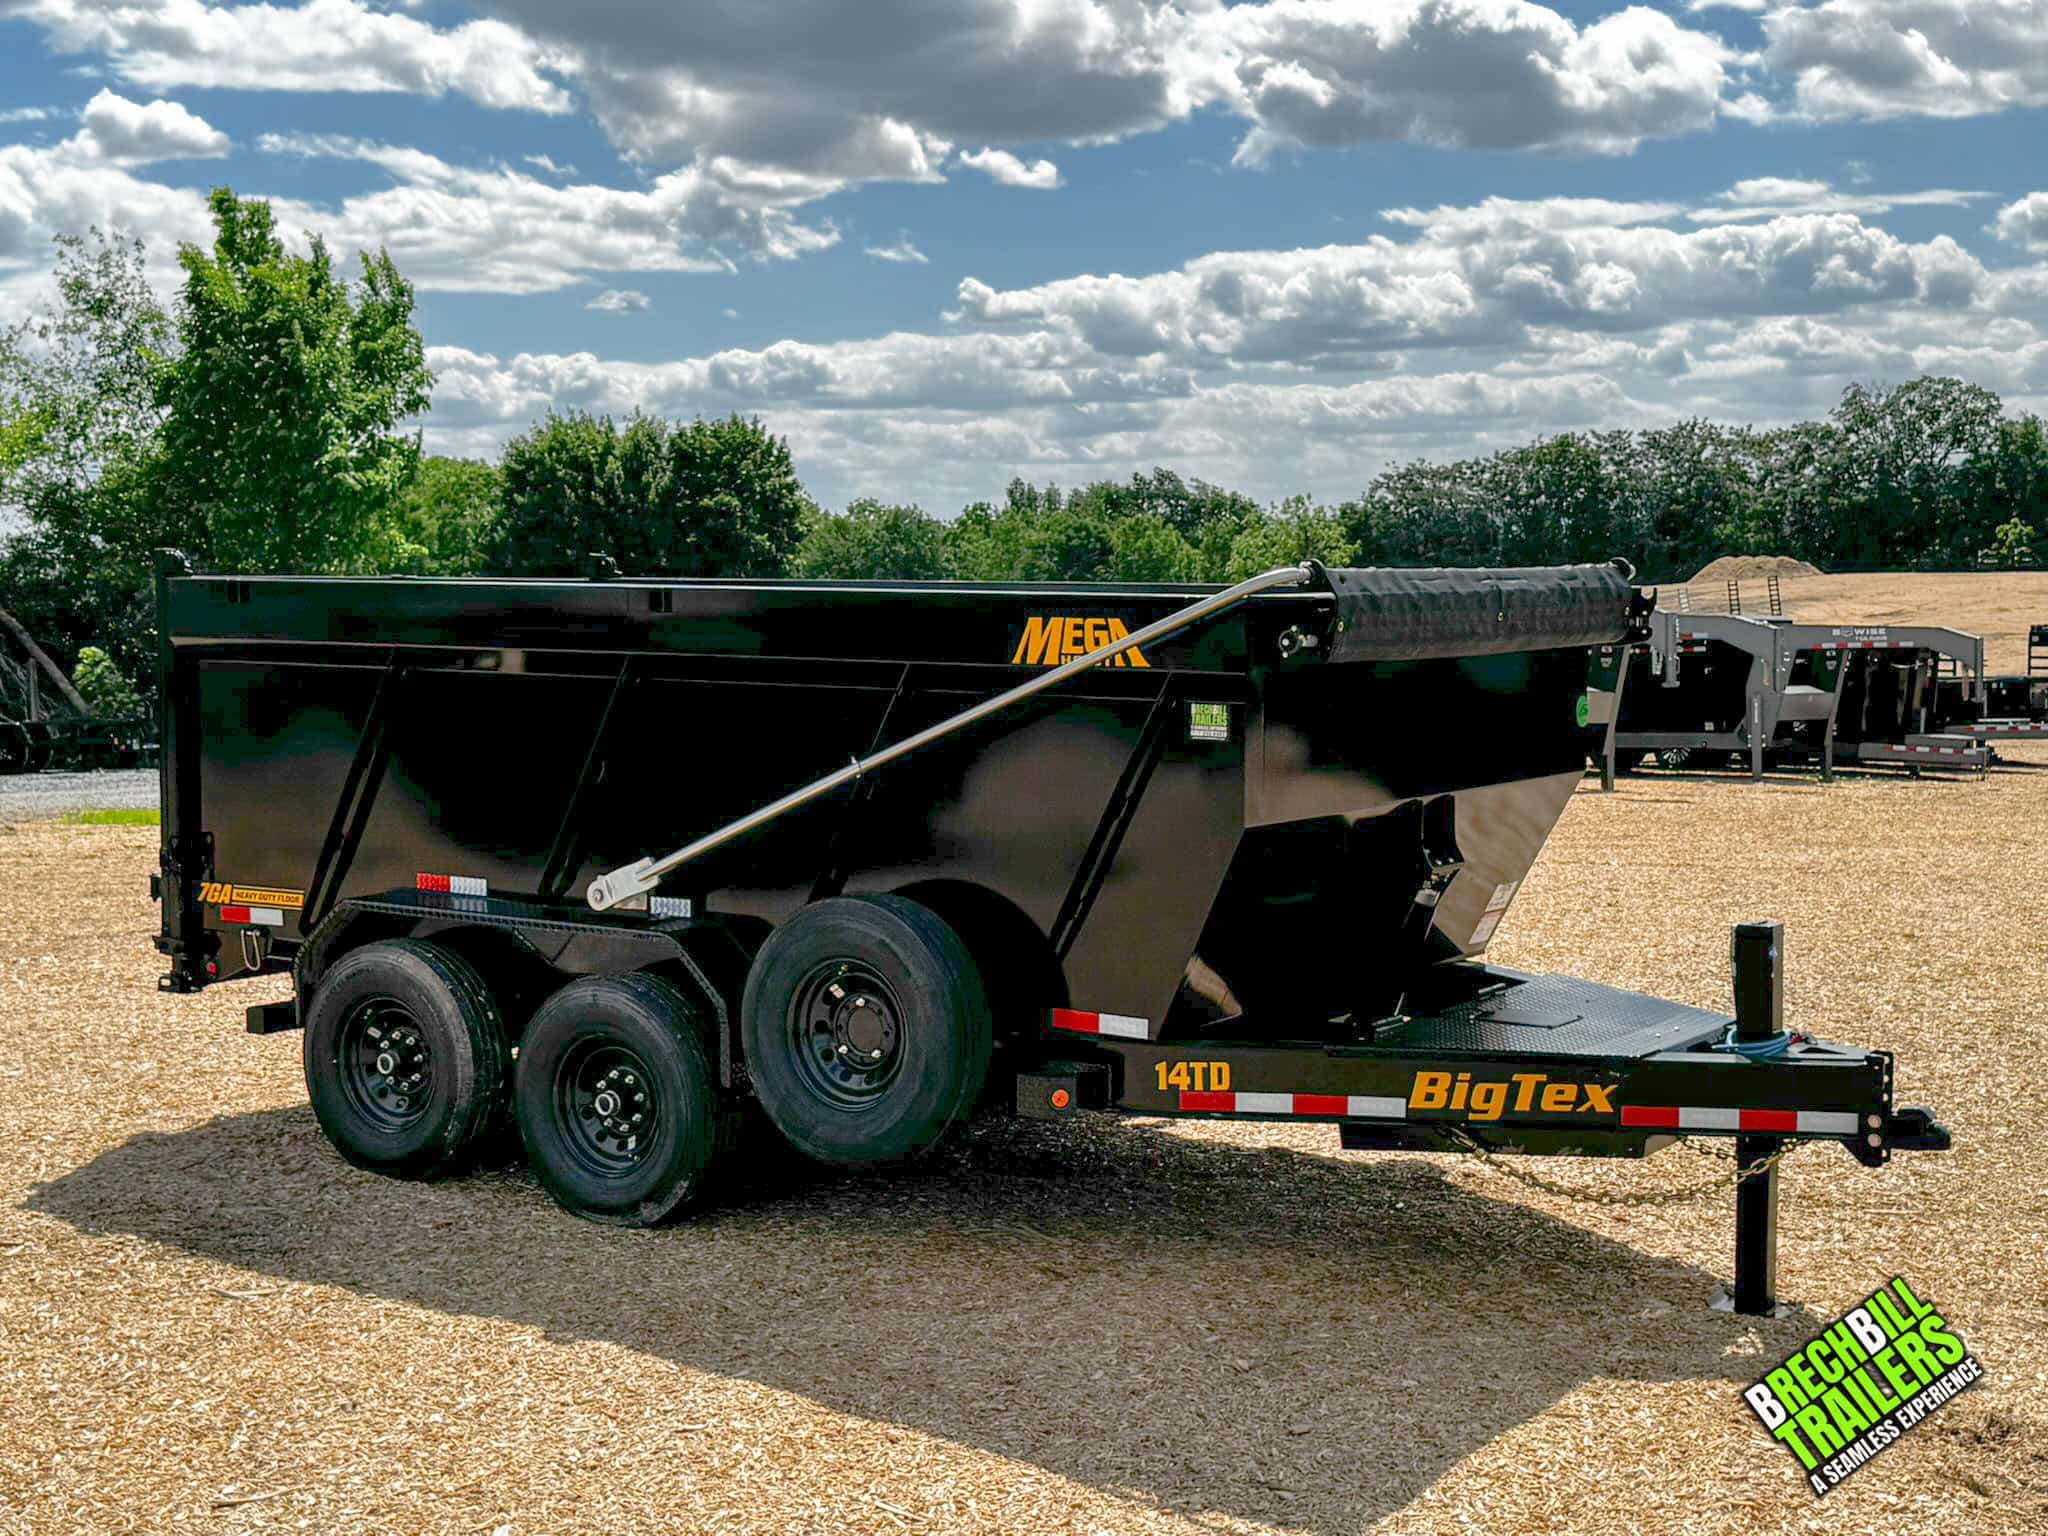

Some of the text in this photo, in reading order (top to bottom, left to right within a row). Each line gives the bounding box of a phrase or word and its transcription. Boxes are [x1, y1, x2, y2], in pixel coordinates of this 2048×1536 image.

[1012, 616, 1151, 668] MEGA
[197, 881, 300, 905] 7GA HEAVY DUTY FLOOR
[1156, 1060, 1229, 1092] 14TD
[1408, 1071, 1618, 1122] BigTex
